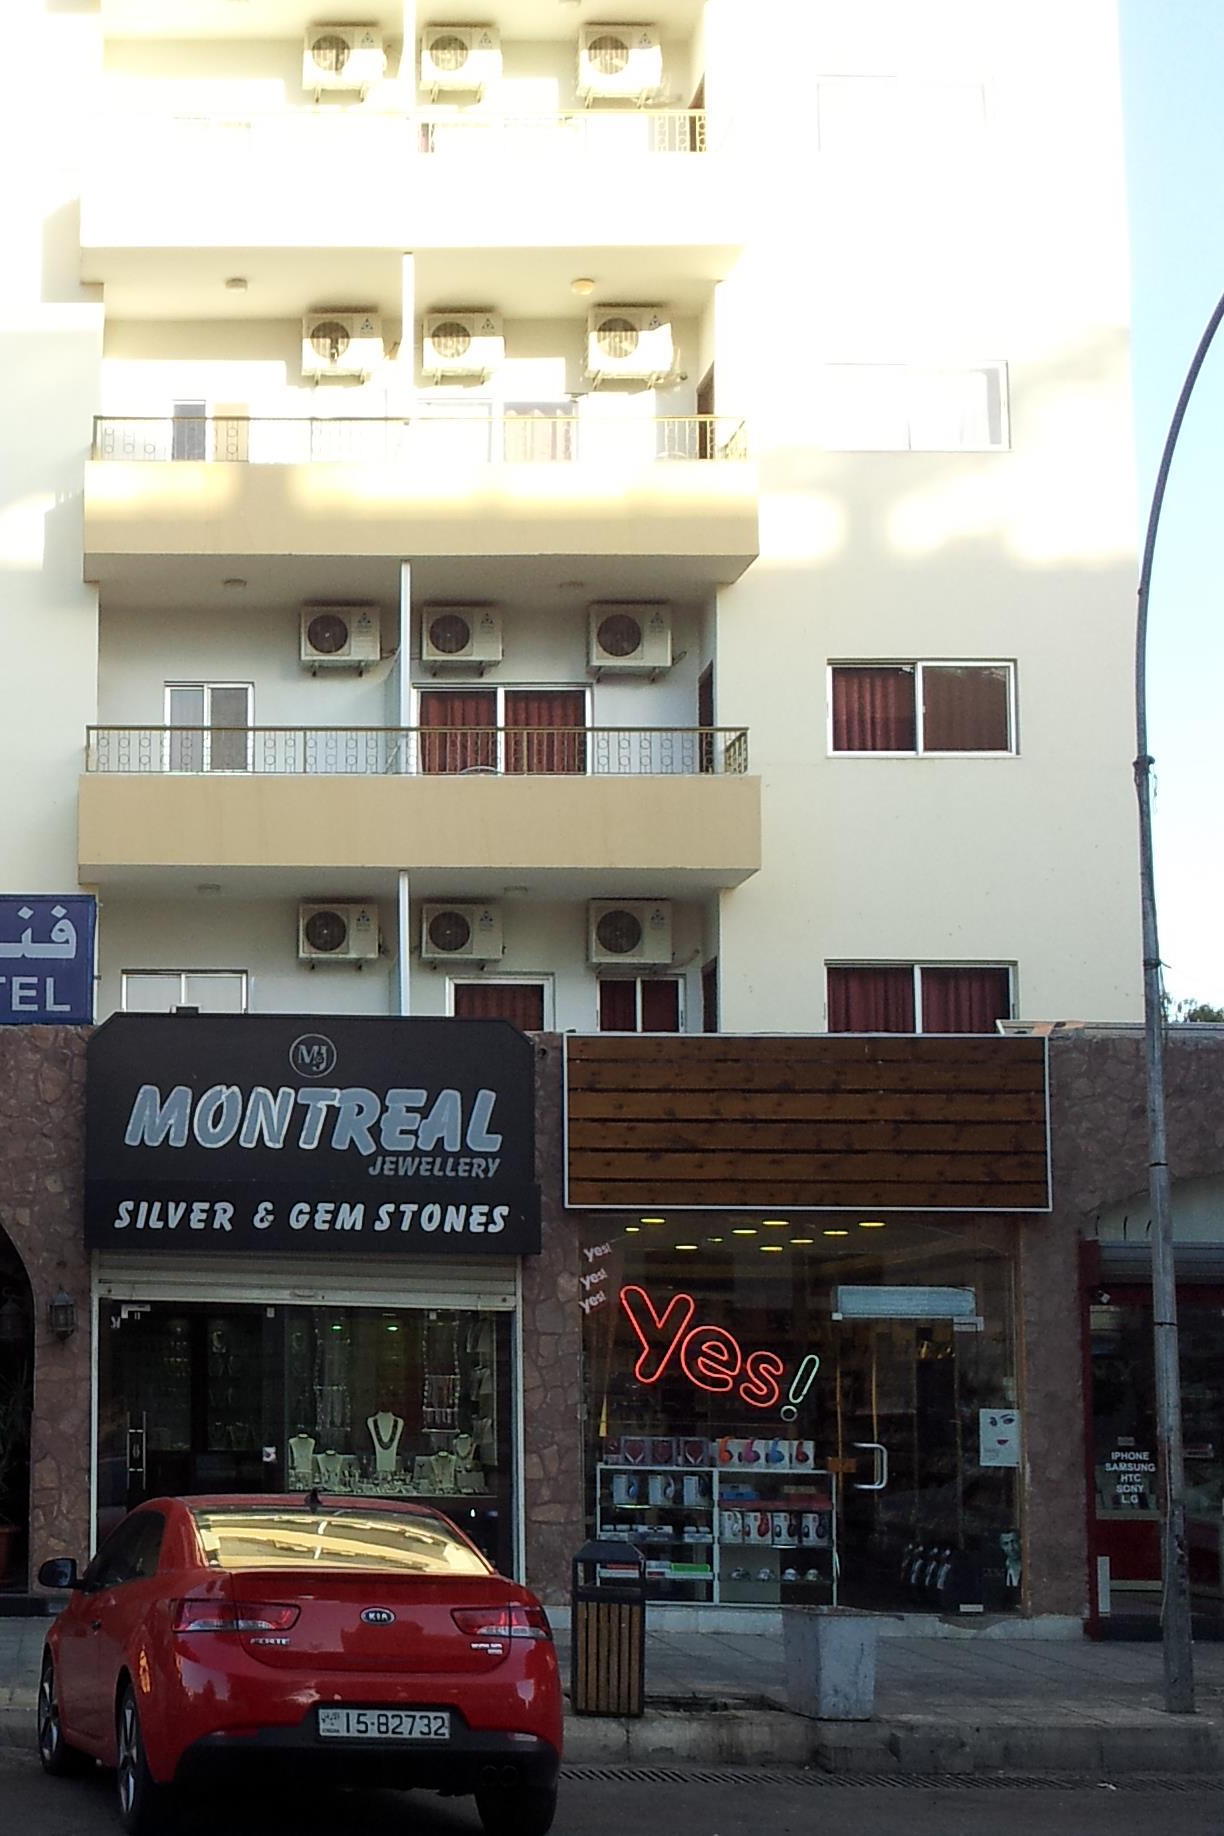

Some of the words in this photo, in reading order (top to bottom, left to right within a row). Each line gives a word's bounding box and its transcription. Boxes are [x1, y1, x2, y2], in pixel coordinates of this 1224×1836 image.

[124, 1084, 503, 1156] MONTREAL
[368, 1156, 501, 1178] JEWELLERY
[114, 1201, 233, 1232] SILVER
[253, 1201, 274, 1230] &
[289, 1202, 364, 1232] GEM
[374, 1204, 510, 1234] STONES
[1111, 1451, 1150, 1460] IPHONE
[1105, 1462, 1156, 1472] SAMSUNG
[1120, 1473, 1141, 1483] HTC
[1115, 1484, 1144, 1493] SONY
[369, 1611, 388, 1621] KIA
